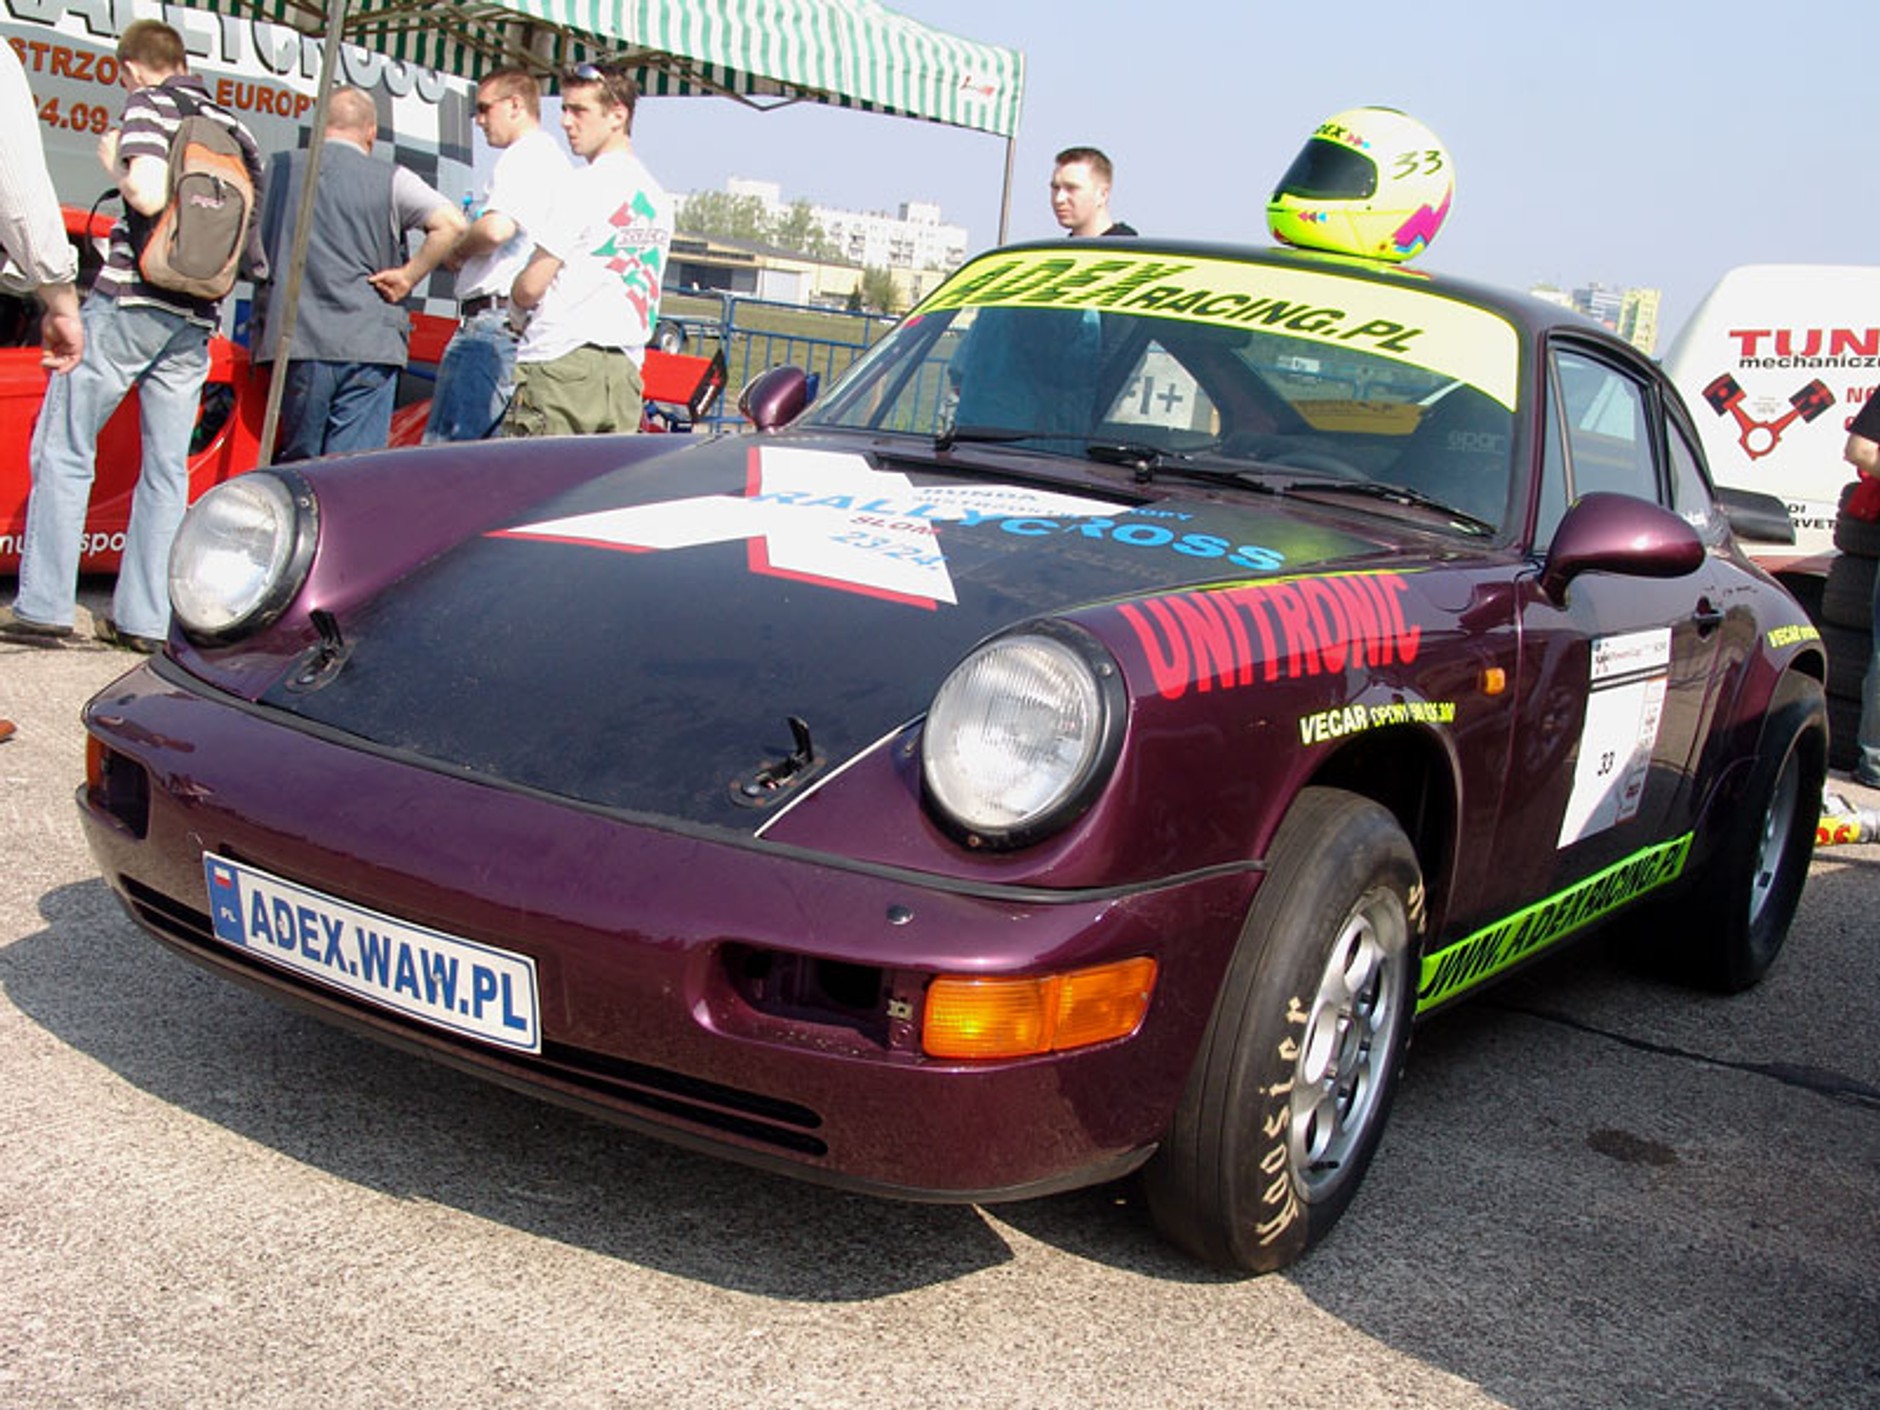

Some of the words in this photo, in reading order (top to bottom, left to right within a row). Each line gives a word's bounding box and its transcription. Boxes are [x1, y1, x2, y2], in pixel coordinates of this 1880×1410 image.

[33, 94, 119, 134] 4.09.
[216, 79, 319, 119] EUROP
[1393, 150, 1443, 180] 33
[1739, 355, 1880, 369] mechanicz
[752, 491, 1286, 571] RALLYCROSS
[1117, 574, 1421, 700] UNITRONIC
[1300, 705, 1368, 744] VECAR
[221, 906, 237, 923] PL
[251, 889, 527, 1032] ADEX.WAW.PL
